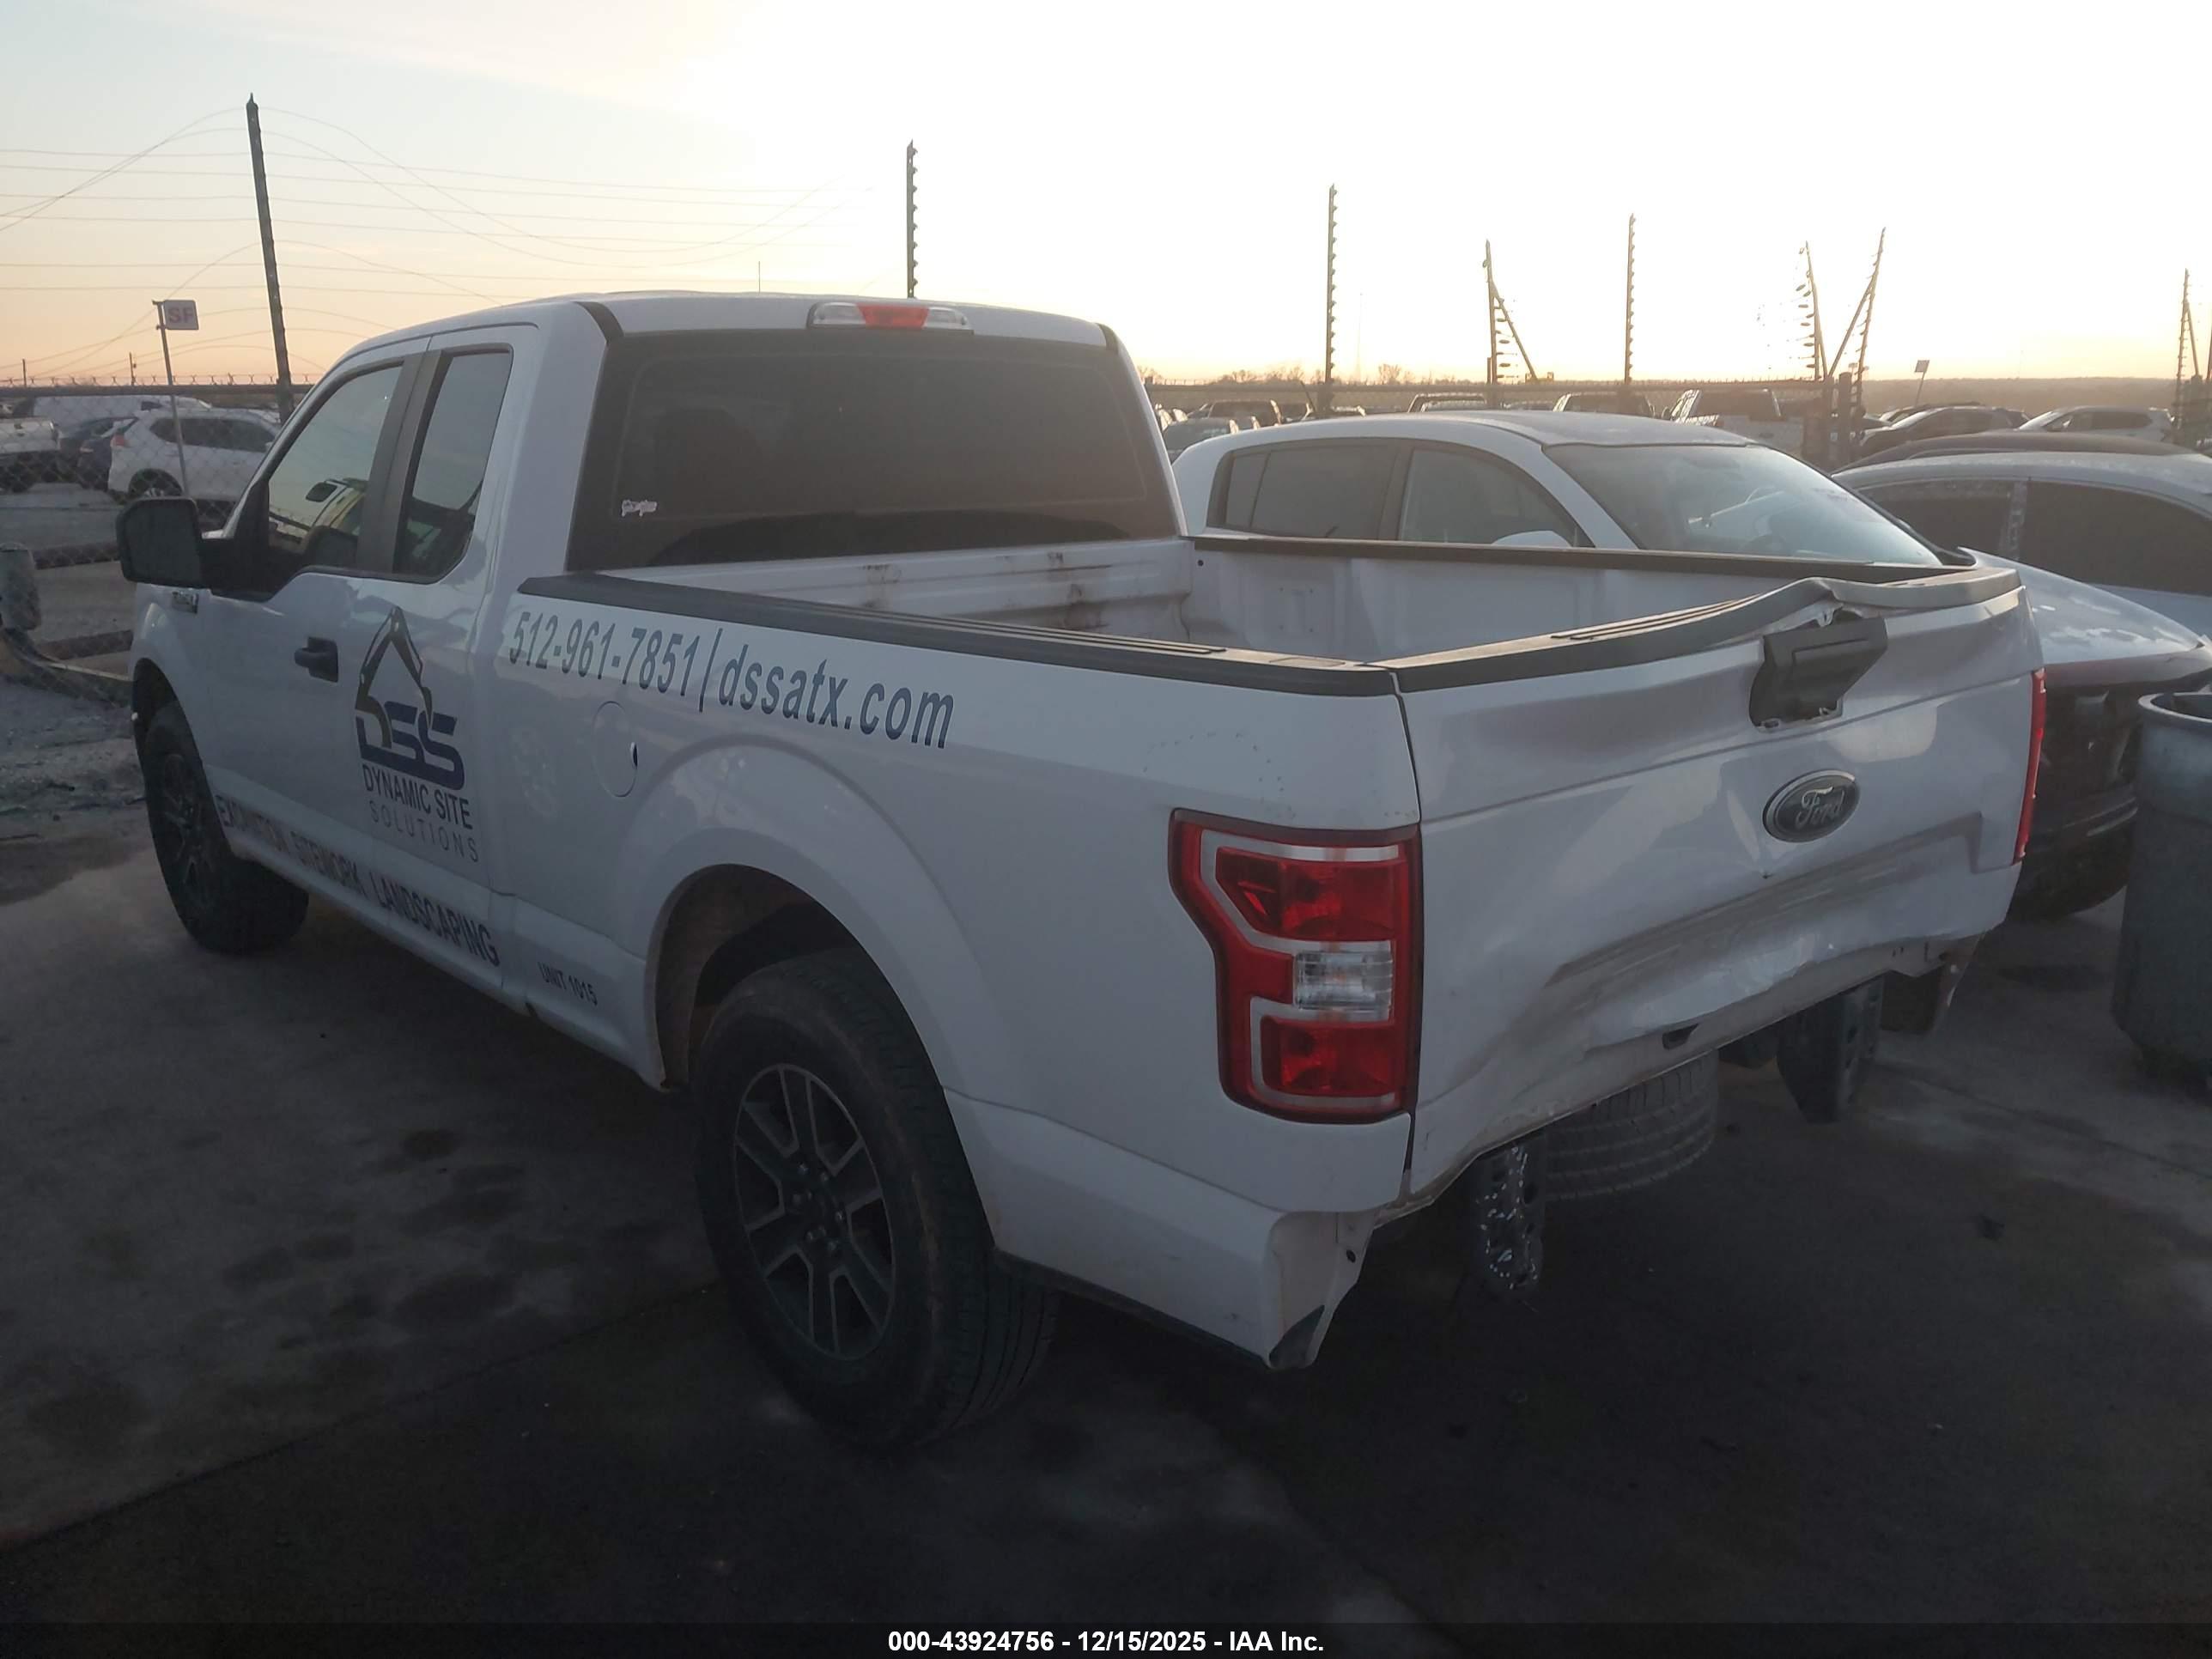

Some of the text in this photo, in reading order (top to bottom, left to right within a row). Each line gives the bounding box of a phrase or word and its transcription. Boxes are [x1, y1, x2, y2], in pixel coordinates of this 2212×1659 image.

[167, 307, 193, 324] SF
[509, 611, 700, 697] 512-961-7851
[719, 644, 955, 750] dssatx.com
[362, 764, 473, 830] DYNAMIC SITE
[1796, 785, 1844, 830] Ford
[369, 800, 479, 863] SOLUTIONS
[369, 871, 501, 968] LANDSCAPING
